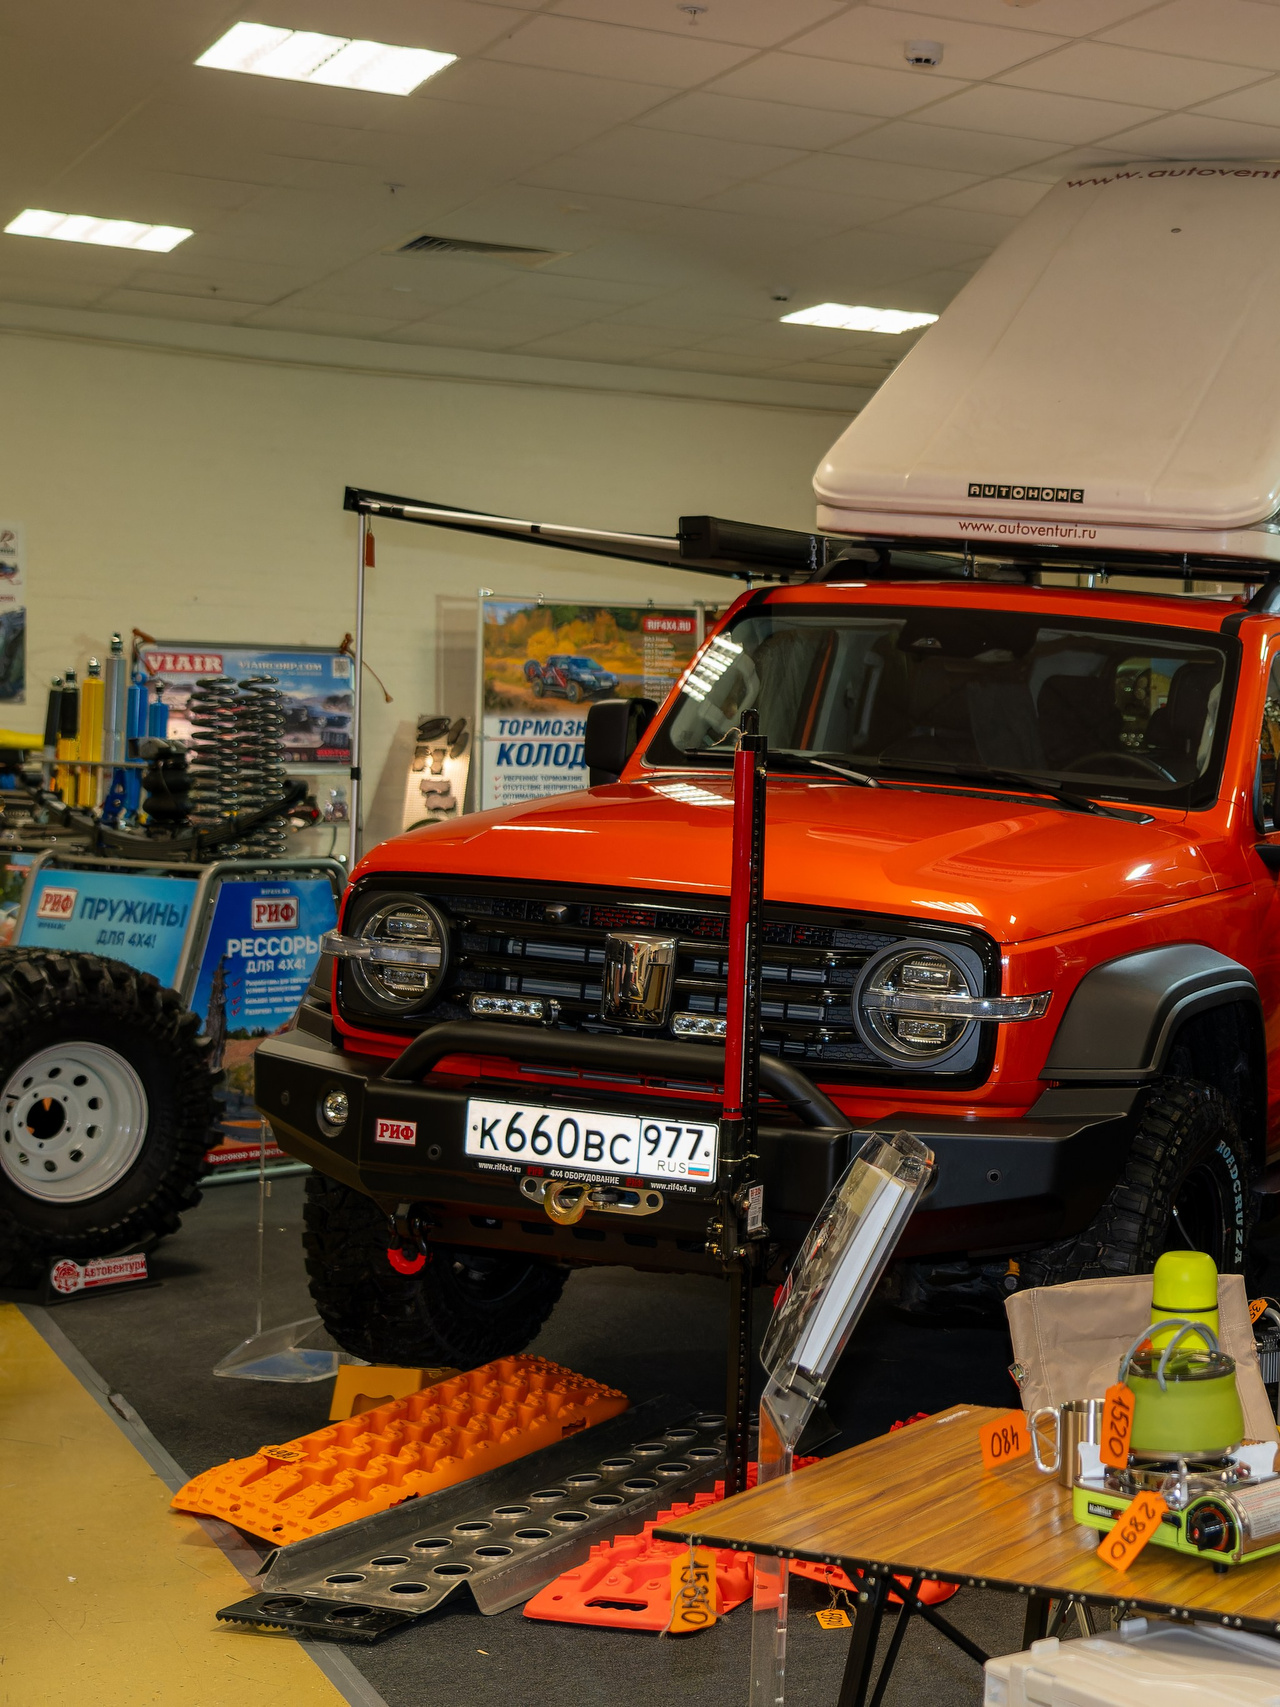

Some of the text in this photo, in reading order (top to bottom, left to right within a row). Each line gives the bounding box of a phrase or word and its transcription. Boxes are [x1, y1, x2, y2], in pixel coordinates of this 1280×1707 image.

[968, 483, 1084, 503] AUTOHOME
[959, 521, 1097, 540] www.autoventuri.ru
[148, 654, 223, 673] VIAIR
[498, 720, 588, 737] ТОРМОЗН
[496, 742, 588, 770] КОЛОД
[42, 893, 74, 913] РИФ
[79, 896, 189, 928] ПРУЖИНЫ
[255, 903, 295, 923] РИФ
[96, 929, 125, 945] ДЛЯ
[226, 935, 322, 958] РЕССОРЫ
[246, 960, 275, 975] ДЛЯ
[379, 1123, 414, 1140] РИФ
[644, 1125, 704, 1160] 977
[478, 1161, 522, 1174] www.rif4x4.ru
[657, 1159, 687, 1175] RUS
[564, 1171, 620, 1186] ОБОРУДОВАНИЕ
[650, 1182, 697, 1193] www.rif4x4.ru
[1216, 1139, 1244, 1264] ROADCRUZA
[1109, 1396, 1130, 1459] 1520
[990, 1424, 1020, 1457] 480
[1110, 1502, 1156, 1560] 2890
